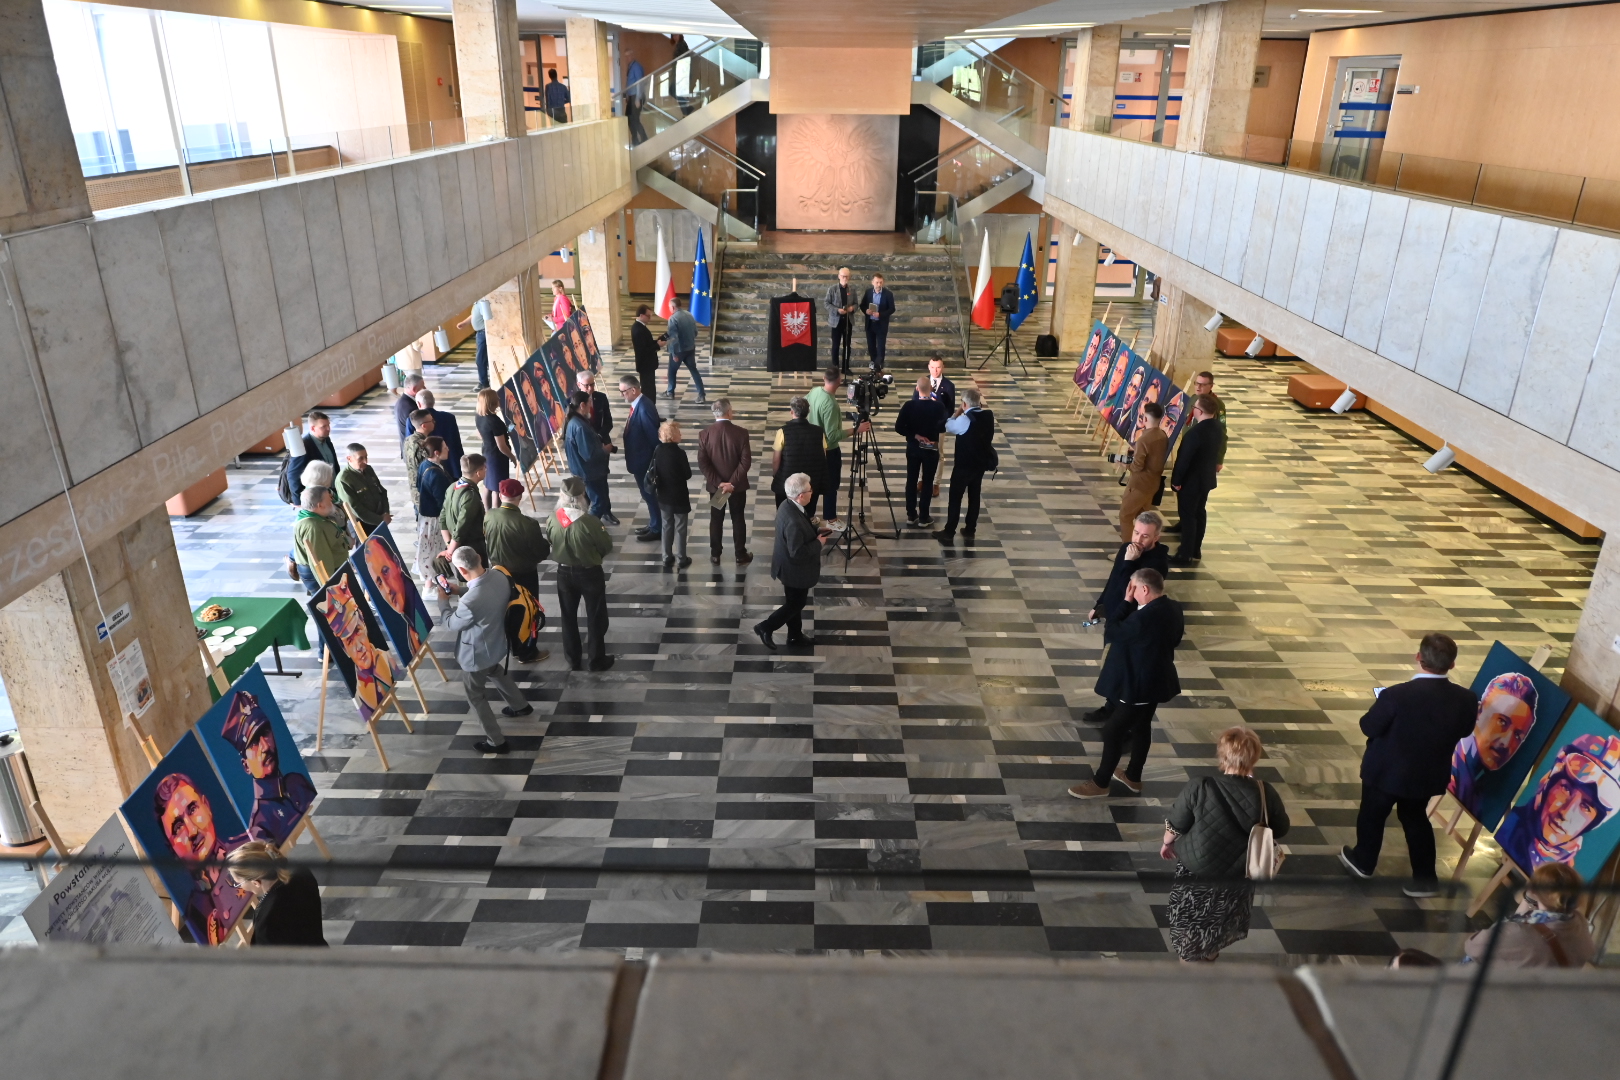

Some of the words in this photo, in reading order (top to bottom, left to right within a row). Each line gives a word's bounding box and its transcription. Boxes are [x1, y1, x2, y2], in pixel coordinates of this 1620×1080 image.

[0, 492, 124, 592] zeszów
[210, 391, 290, 457] Pleszew
[367, 325, 409, 360] Rawicz
